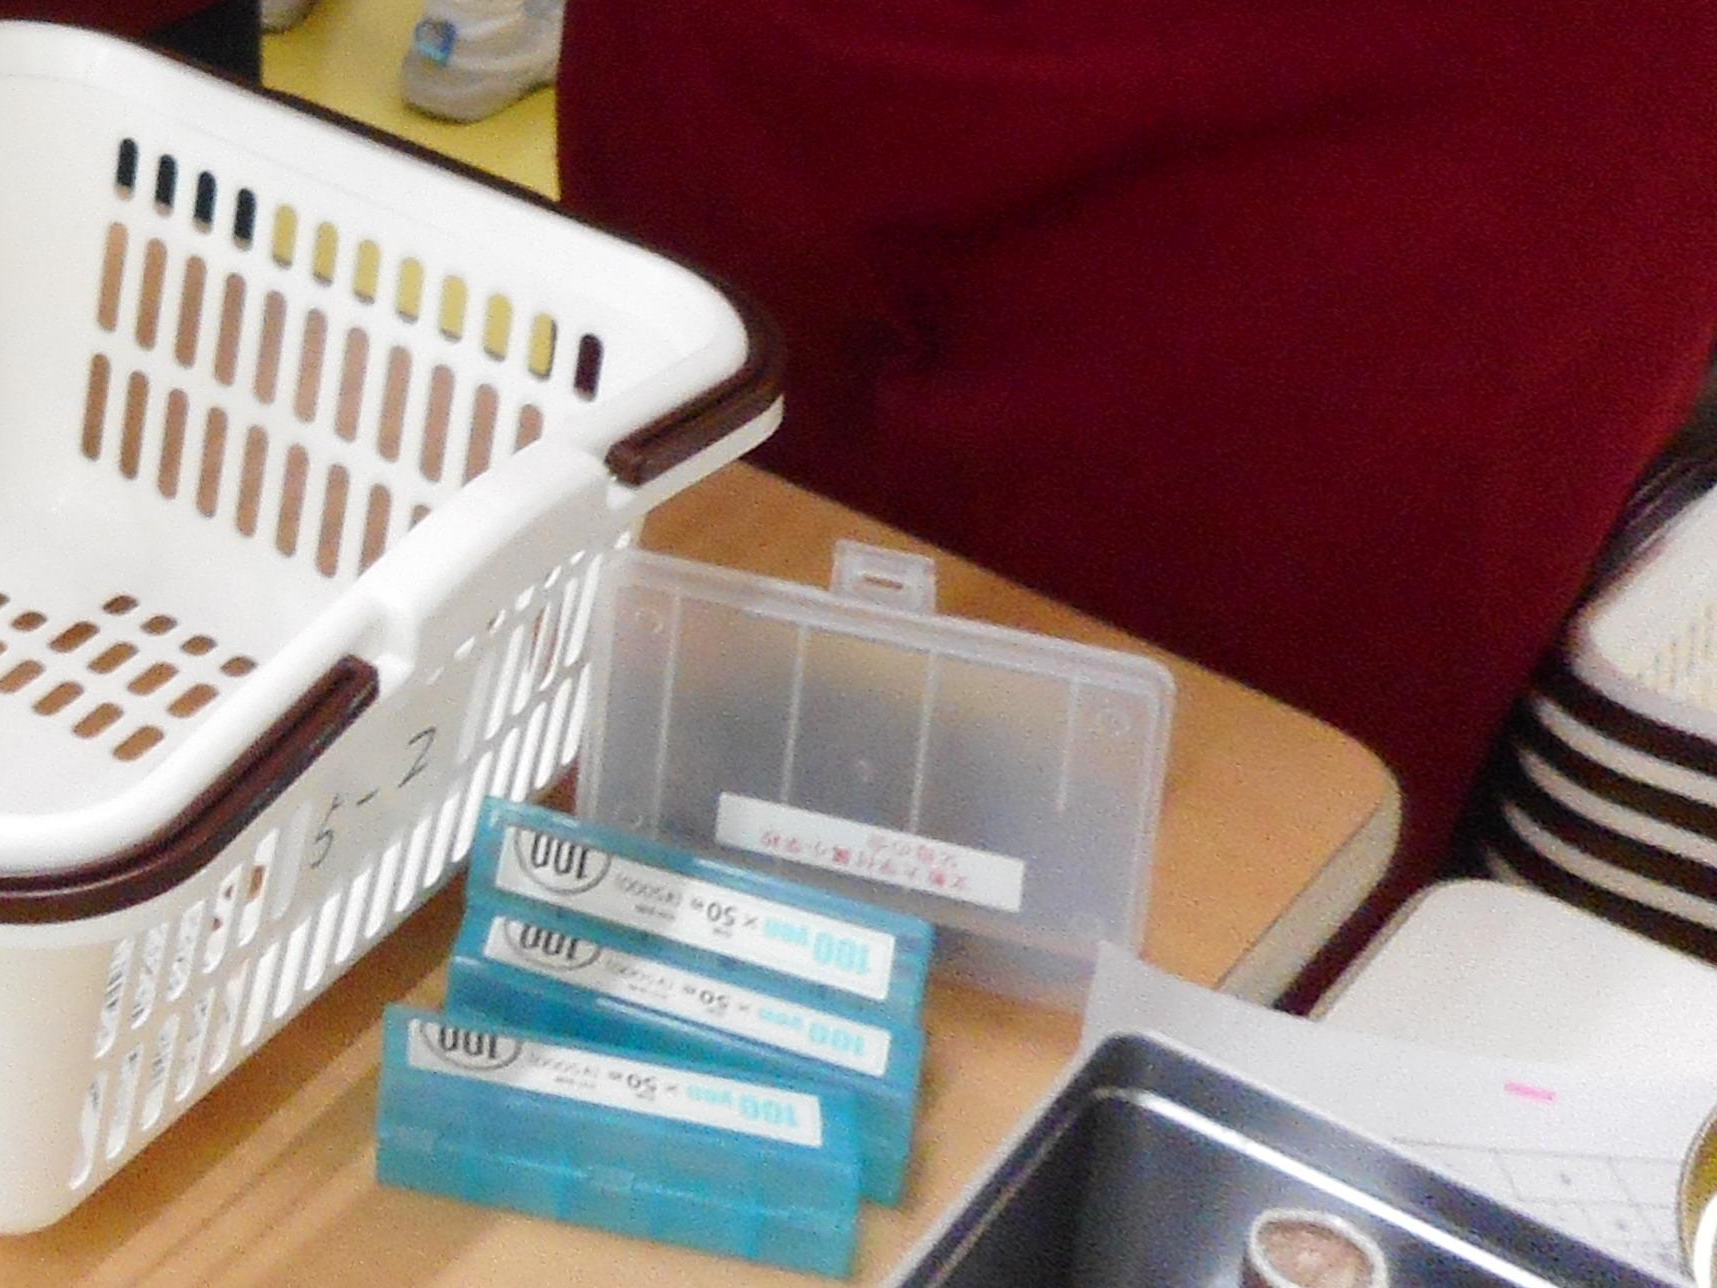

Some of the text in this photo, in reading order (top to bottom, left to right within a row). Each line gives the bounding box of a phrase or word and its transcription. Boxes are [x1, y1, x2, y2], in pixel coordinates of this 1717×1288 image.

[811, 929, 873, 976] 100
[807, 1020, 866, 1057] 100
[738, 1094, 799, 1128] 100
